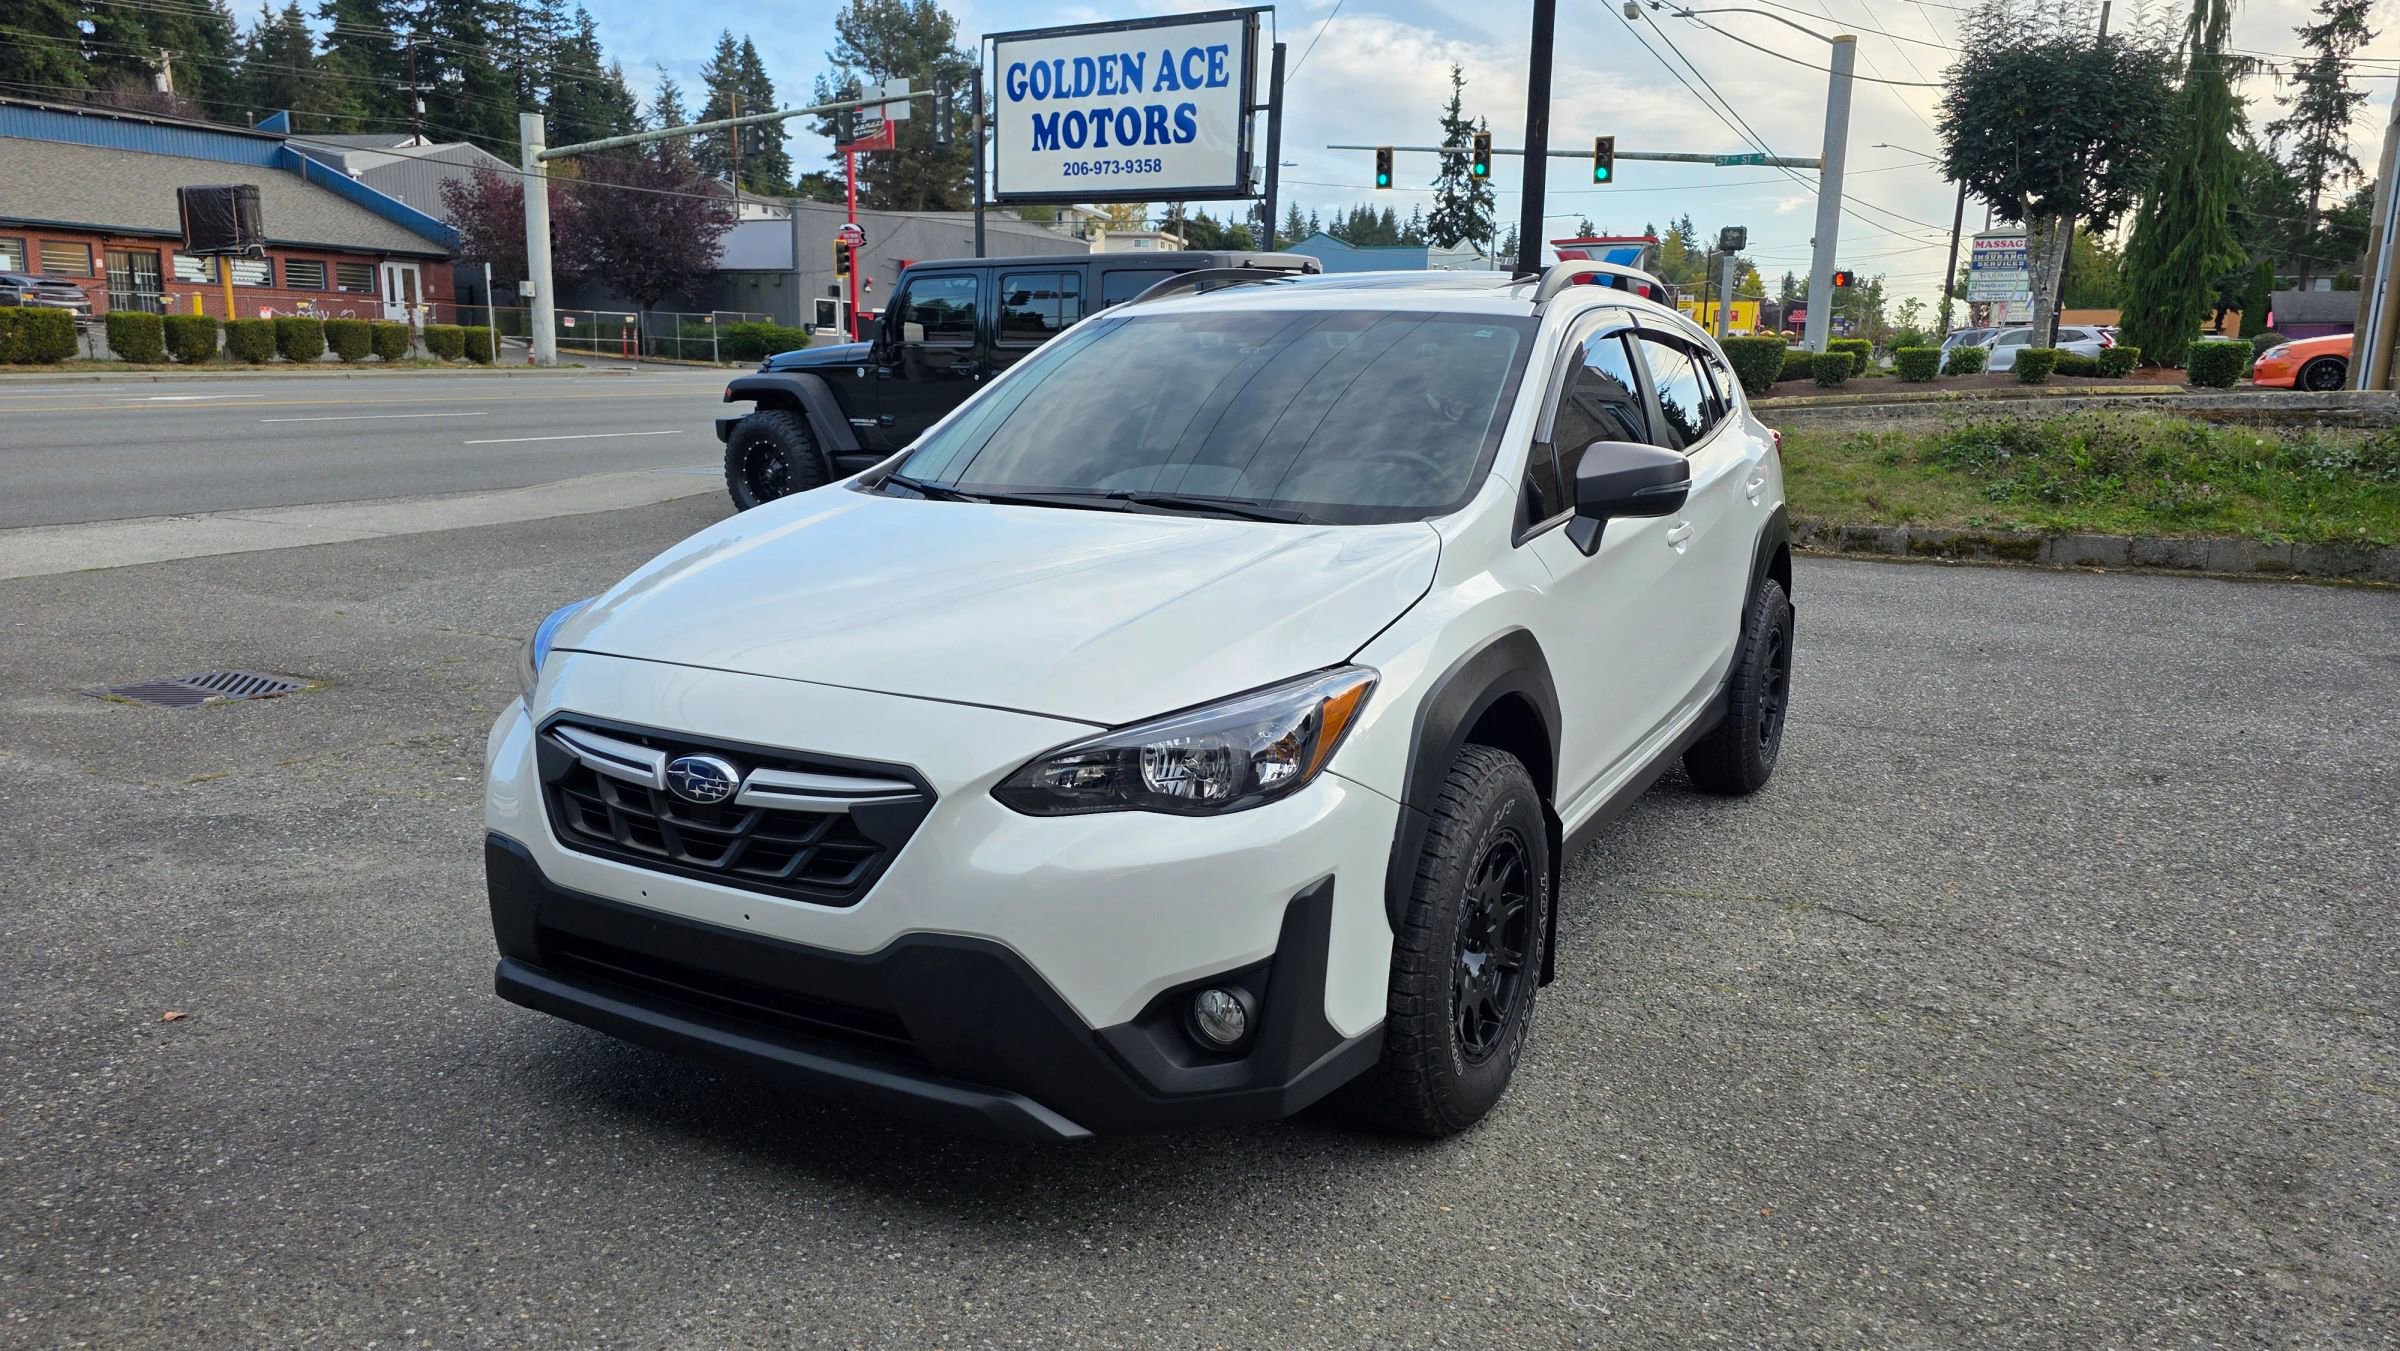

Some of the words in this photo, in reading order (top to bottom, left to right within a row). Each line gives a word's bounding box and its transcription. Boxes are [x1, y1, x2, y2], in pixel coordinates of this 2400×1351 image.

[1006, 51, 1147, 102] GOLDEN
[1152, 43, 1230, 93] ACE
[1031, 102, 1197, 151] MOTORS
[1063, 158, 1162, 176] 206-973-9358
[1741, 155, 1753, 164] ST
[1534, 871, 1549, 964] TOYO
